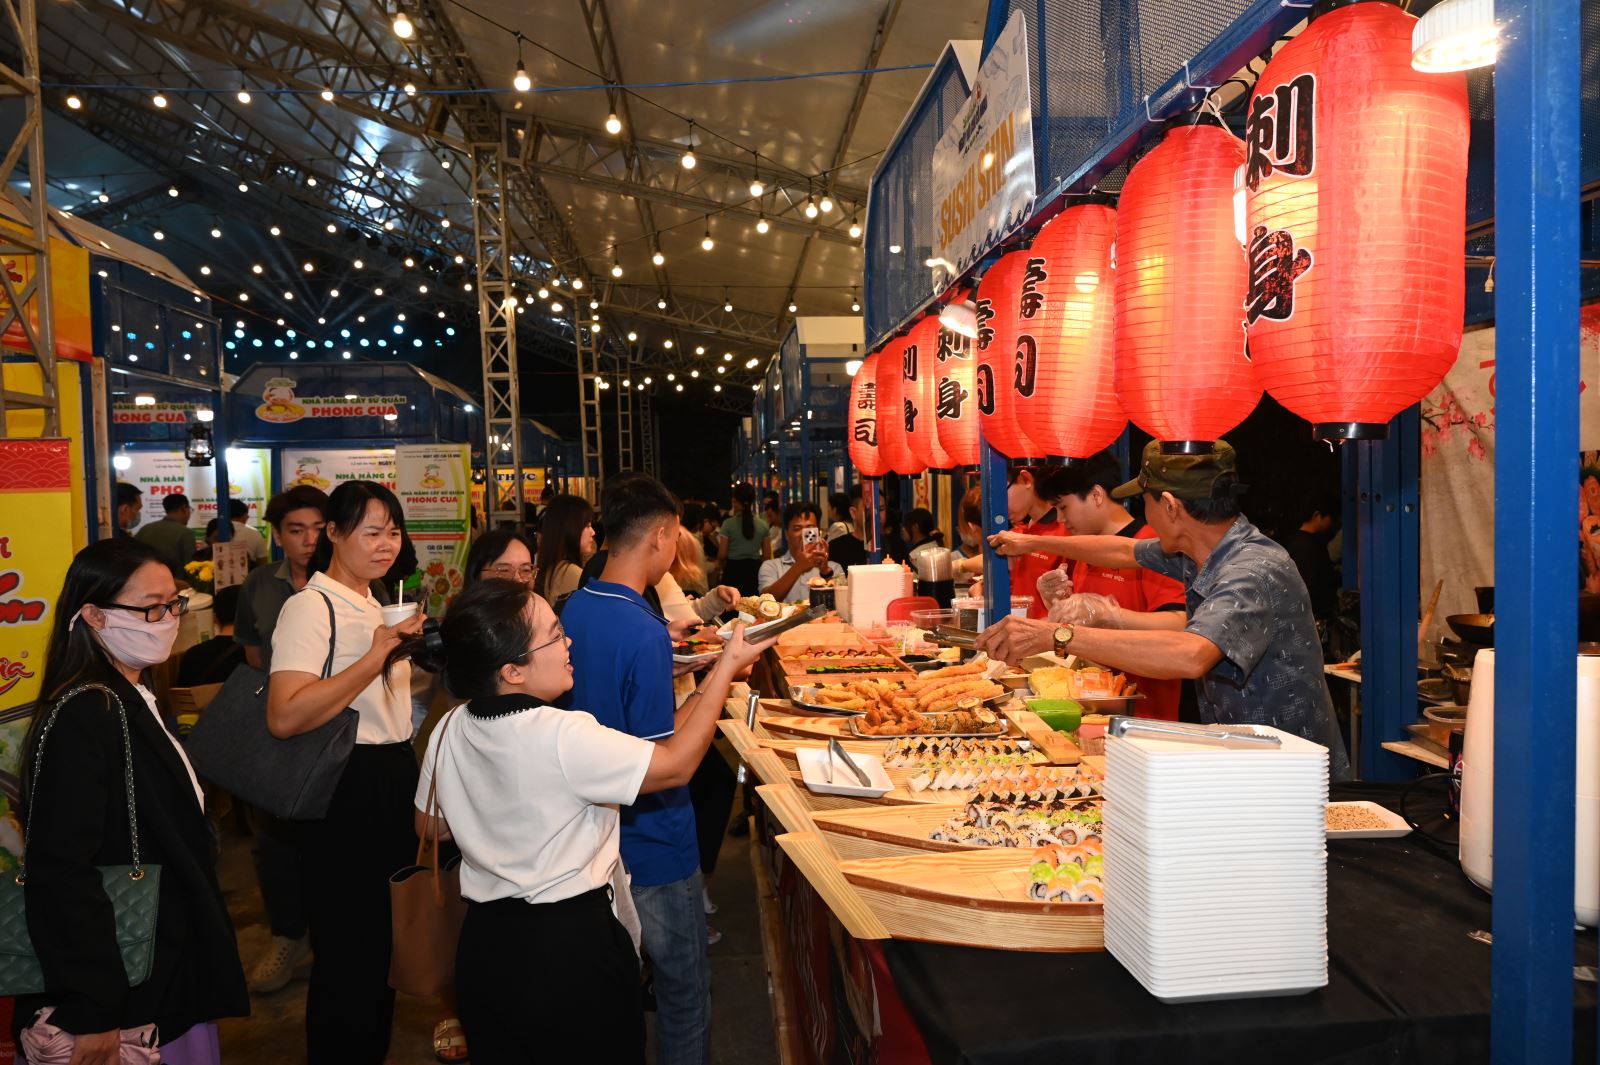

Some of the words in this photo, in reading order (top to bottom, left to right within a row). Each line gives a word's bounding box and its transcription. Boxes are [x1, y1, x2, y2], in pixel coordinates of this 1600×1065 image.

[940, 161, 976, 252] SUSHI
[978, 111, 1016, 211] SHIN
[311, 406, 363, 417] PHONG
[367, 405, 398, 416] CUA
[156, 412, 185, 422] CUA
[140, 475, 160, 483] NHÀ
[335, 471, 356, 480] NHÀ
[358, 471, 385, 479] HÀNG
